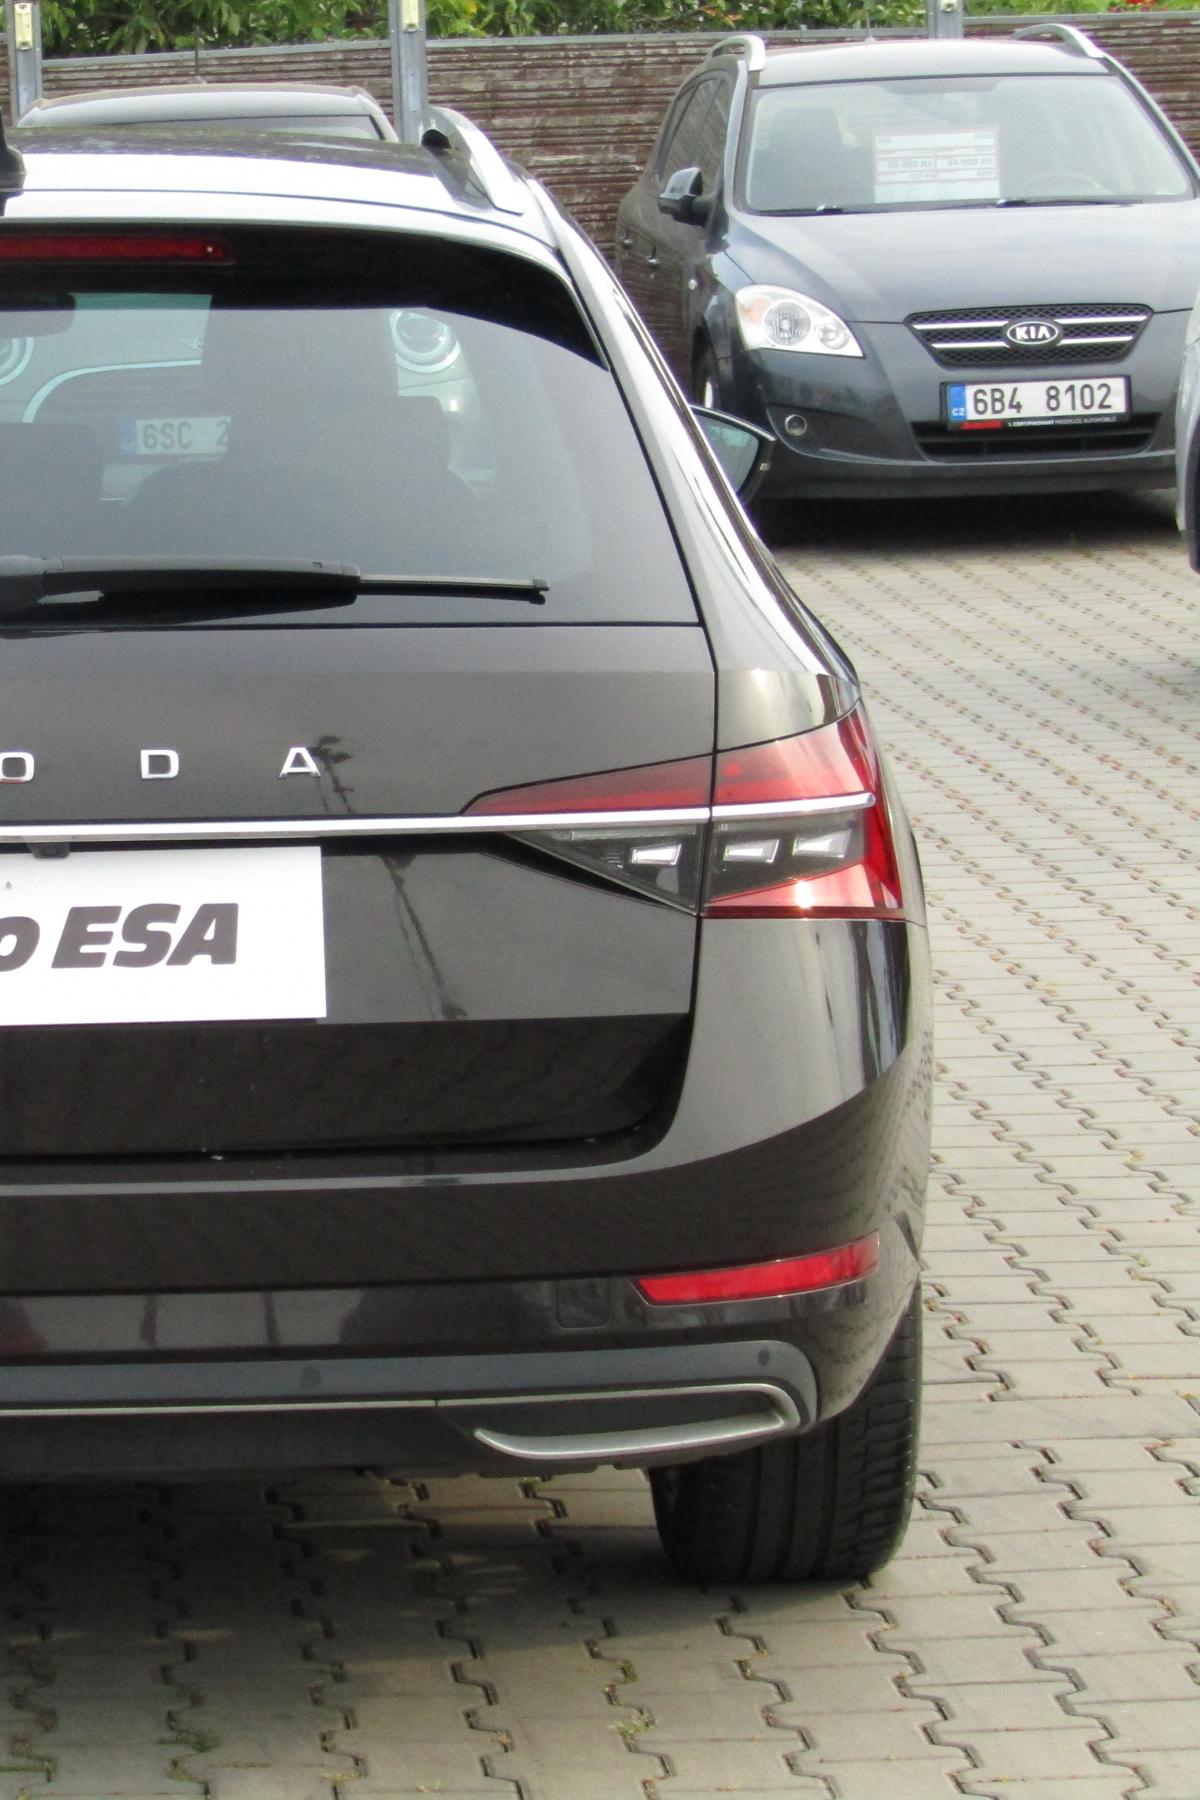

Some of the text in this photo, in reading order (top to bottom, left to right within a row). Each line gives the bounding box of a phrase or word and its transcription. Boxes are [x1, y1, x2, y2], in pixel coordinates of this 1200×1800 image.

[1015, 326, 1051, 340] KIA
[952, 407, 966, 416] CZ
[973, 383, 1112, 415] 6B4 8102
[142, 422, 193, 449] 6SC
[50, 902, 240, 968] ESA
